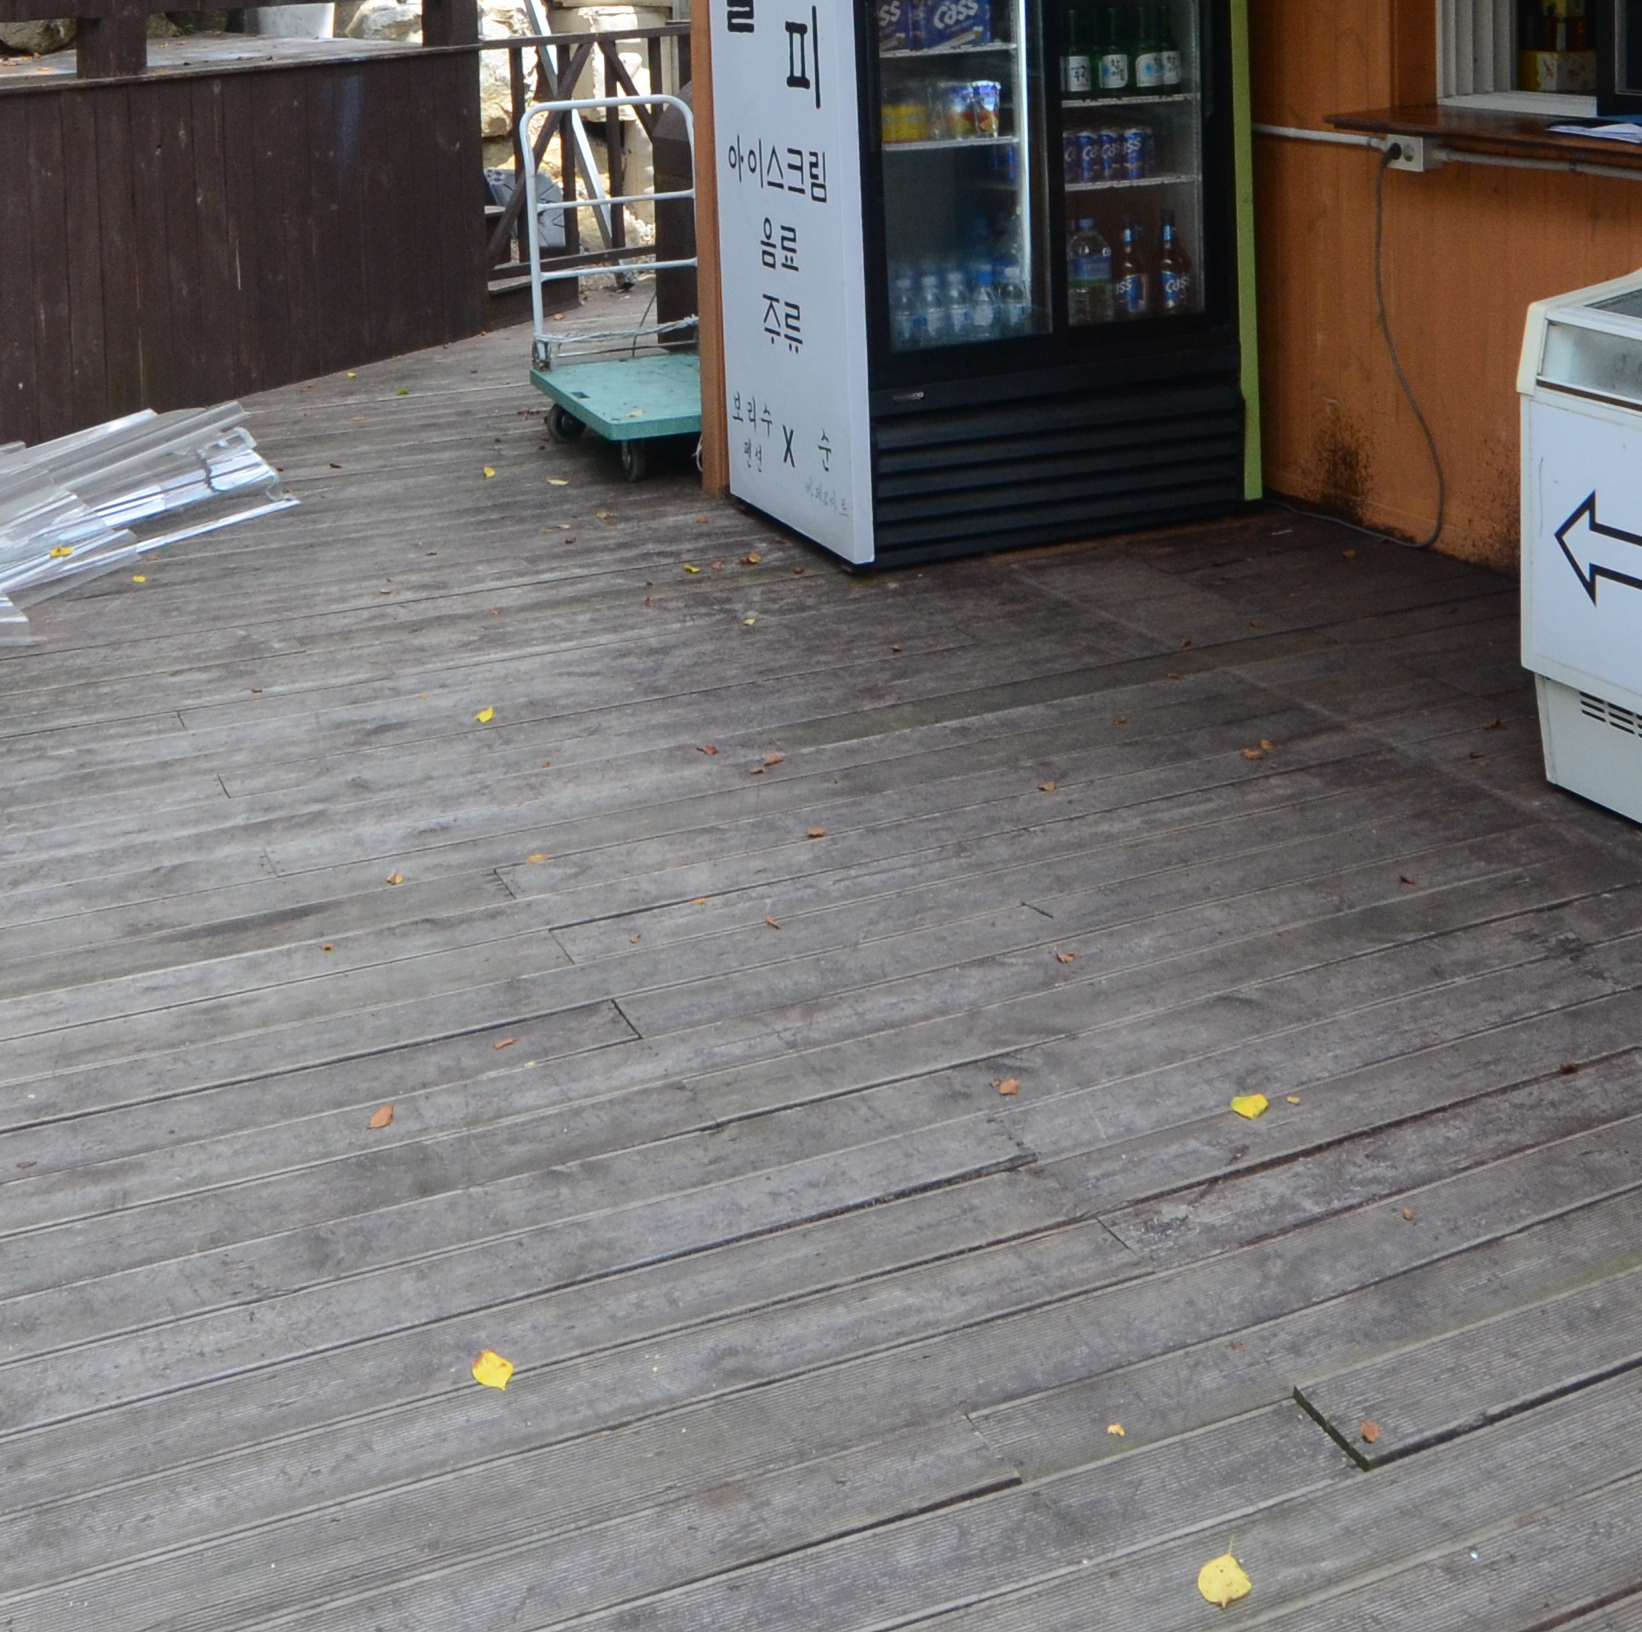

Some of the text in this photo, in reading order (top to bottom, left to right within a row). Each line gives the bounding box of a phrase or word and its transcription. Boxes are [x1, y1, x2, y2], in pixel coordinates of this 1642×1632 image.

[728, 133, 829, 204] 아이스크림
[759, 217, 800, 272] 음료
[762, 293, 804, 355] 주류
[732, 390, 832, 473] 보리수 X 순
